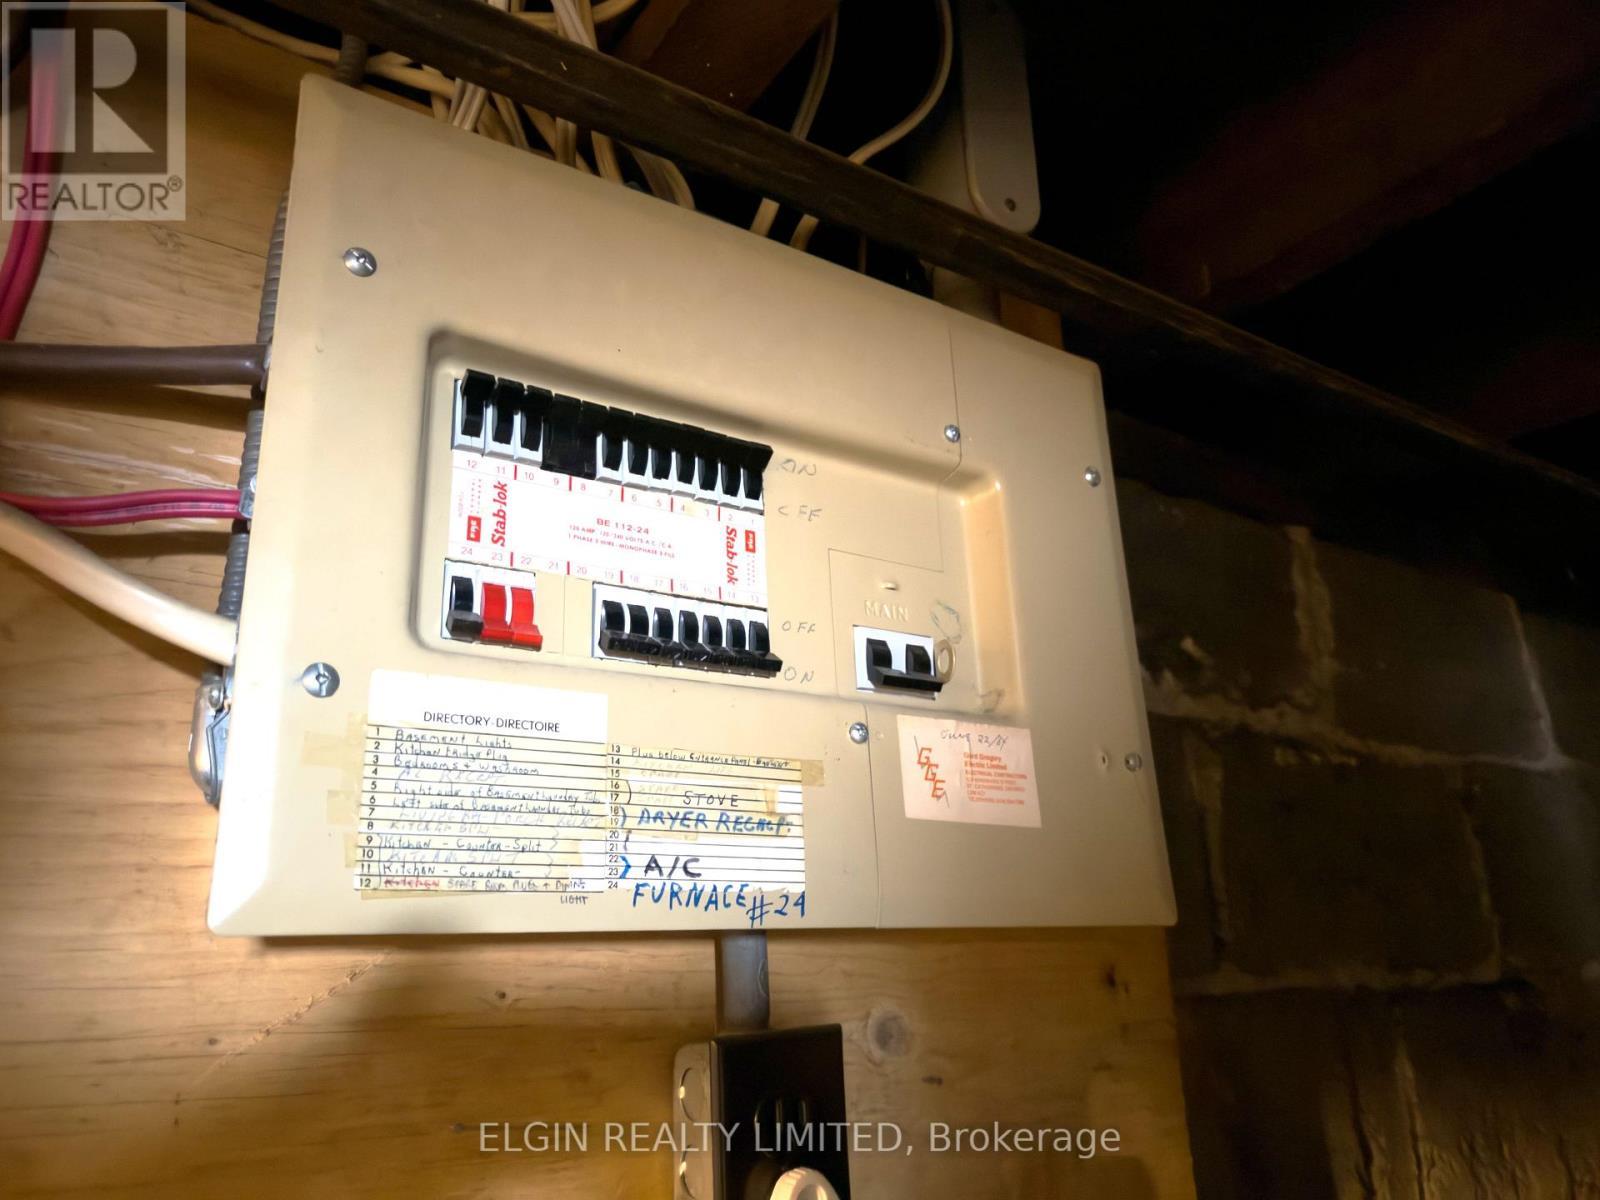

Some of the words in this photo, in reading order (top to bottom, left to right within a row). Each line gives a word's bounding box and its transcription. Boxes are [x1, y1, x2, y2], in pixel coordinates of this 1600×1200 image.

[490, 480, 508, 547] Stab-lok
[725, 525, 739, 585] Stab-lok
[864, 599, 910, 622] MAIN
[781, 620, 816, 634] OFF
[784, 666, 815, 683] ON
[374, 741, 380, 750] 2
[611, 743, 620, 753] 13
[373, 754, 379, 764] 3
[611, 757, 620, 765] 14
[371, 767, 378, 776] 4
[611, 769, 620, 778] 15
[371, 781, 377, 790] 5
[610, 781, 620, 789] 16
[369, 795, 376, 804] 6
[610, 792, 619, 802] 17
[683, 790, 739, 807] STOVE
[368, 807, 375, 816] 7
[610, 806, 619, 815] 18
[367, 821, 374, 830] 8
[610, 817, 620, 826] 19
[609, 830, 619, 839] 20
[366, 835, 373, 845] 9
[609, 843, 619, 852] 21
[362, 849, 373, 859] 10
[609, 854, 619, 863] 22
[361, 863, 371, 873] 11
[644, 854, 702, 878] A/C
[608, 867, 619, 876] 23
[359, 878, 371, 887] 12
[608, 881, 618, 889] 24
[560, 895, 588, 904] LIGHT
[632, 882, 750, 911] FURNACE
[746, 891, 806, 928] #24
